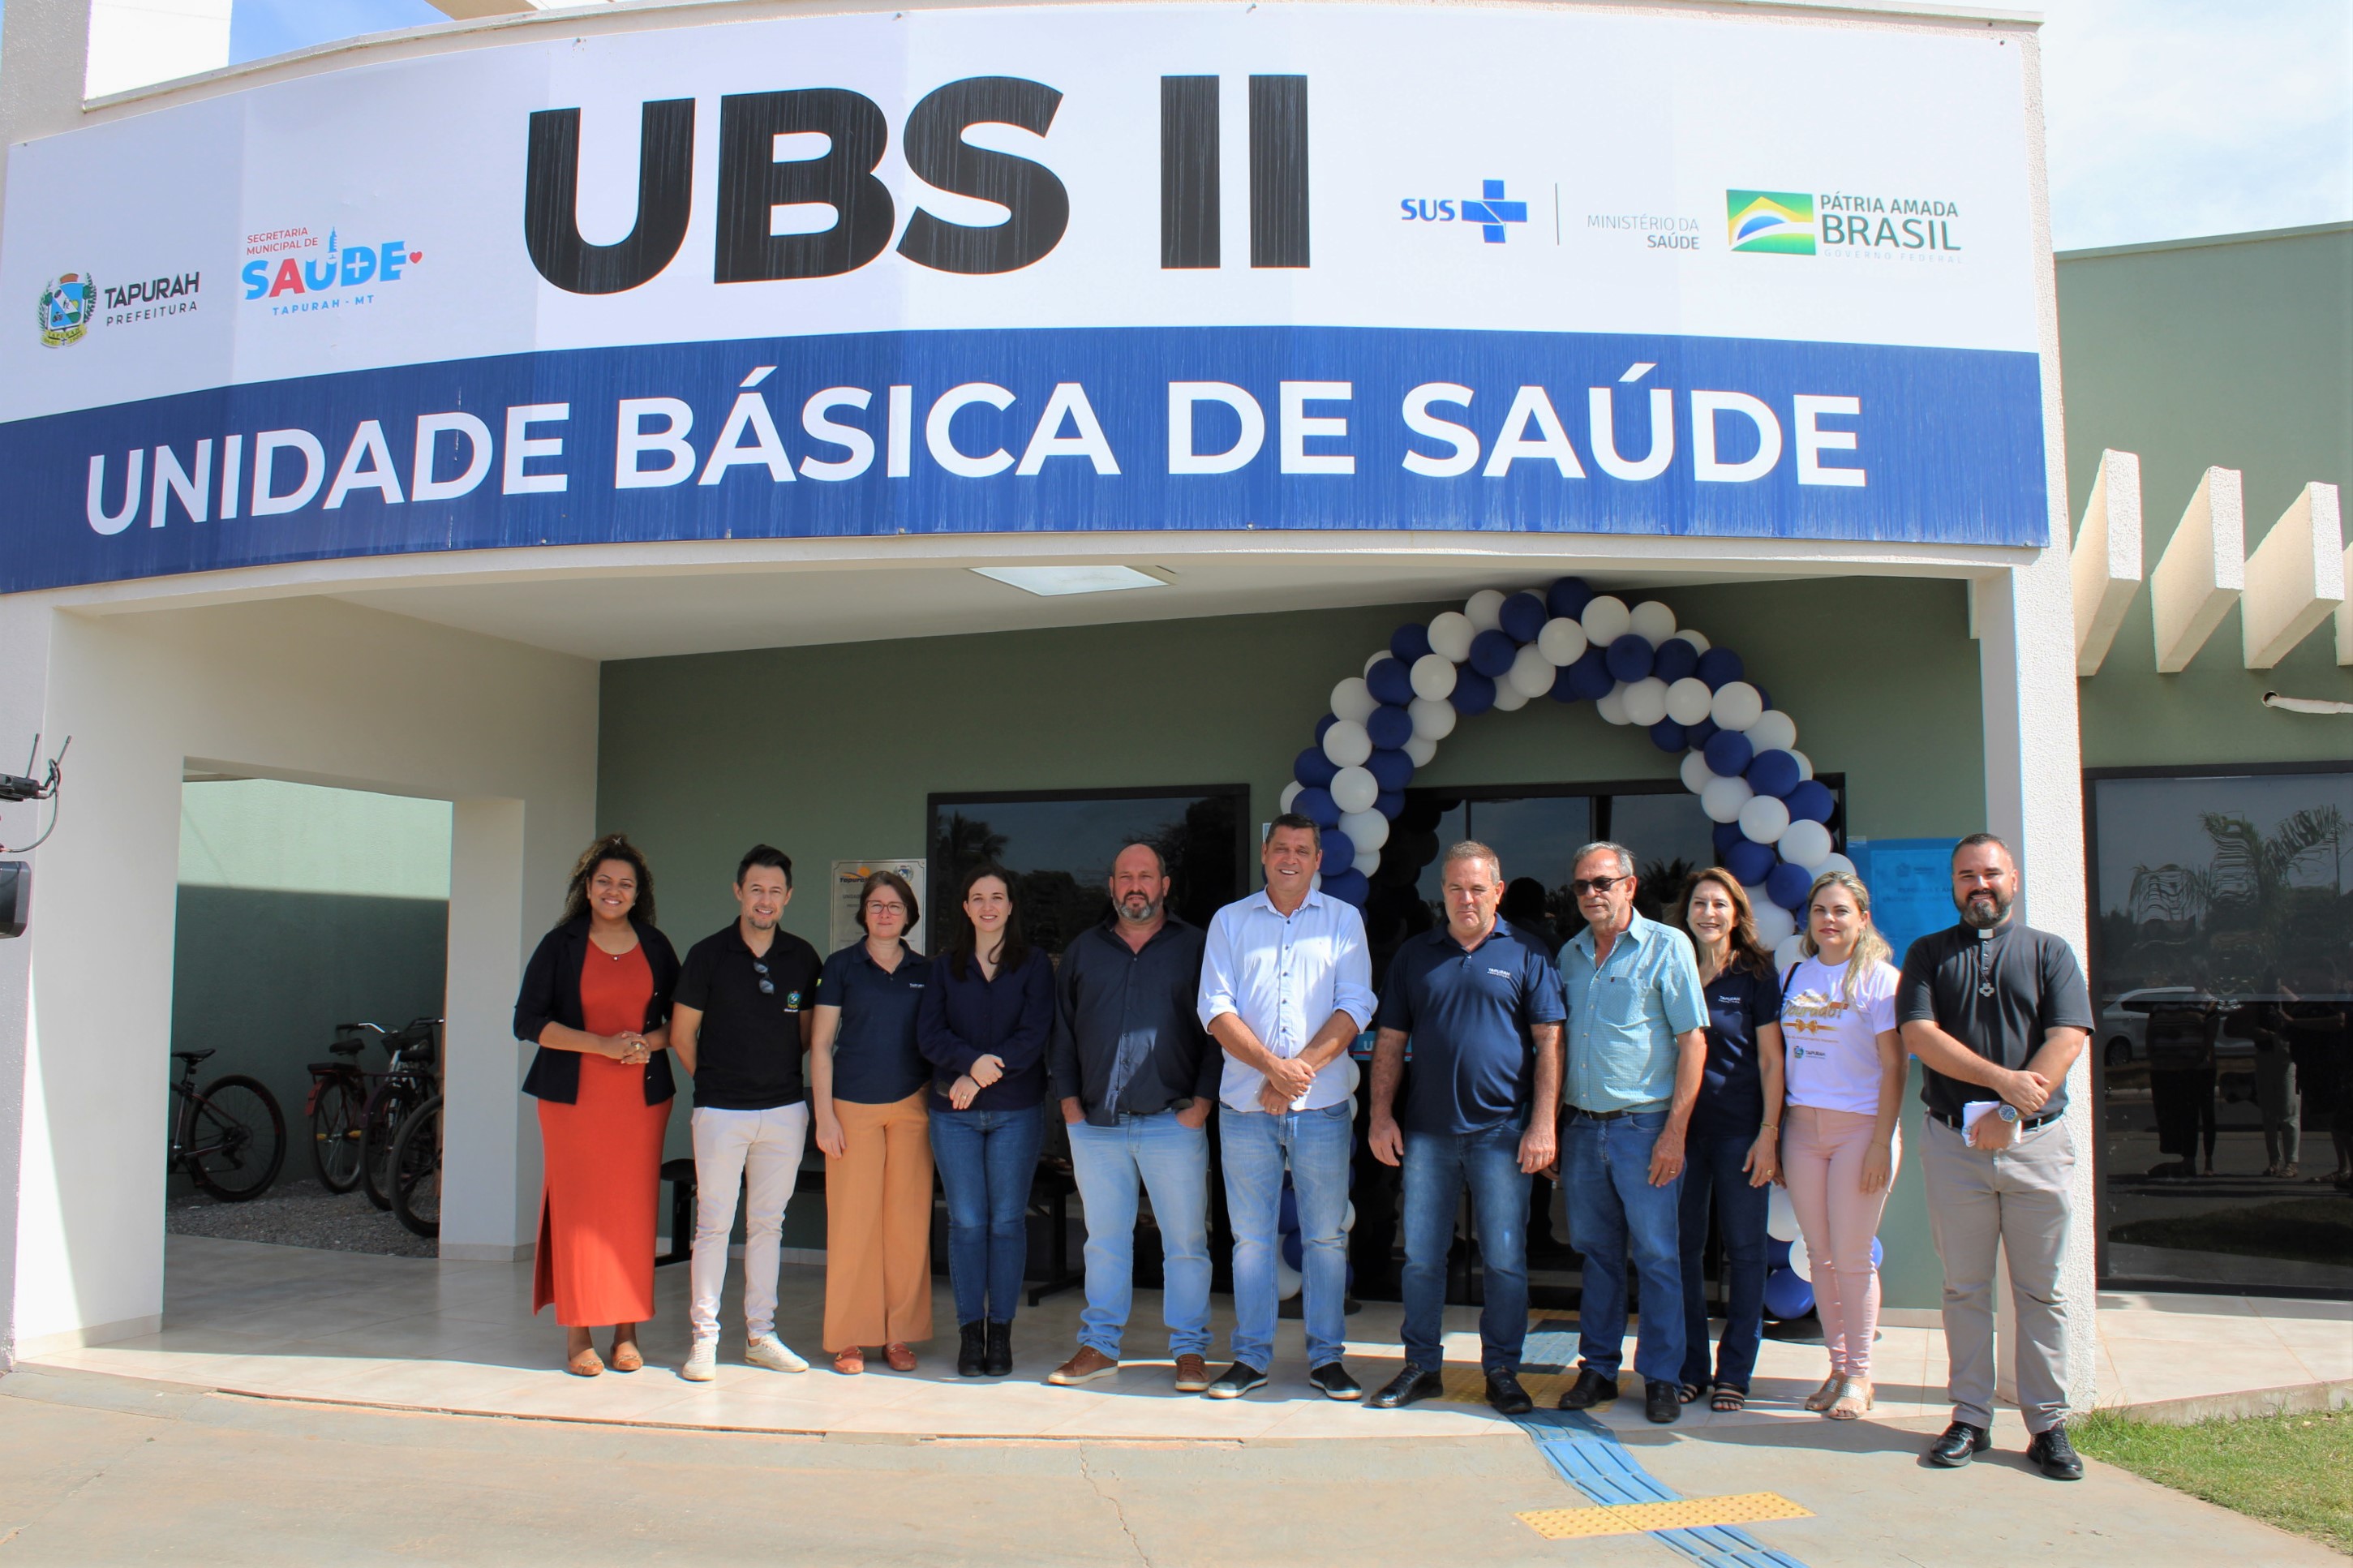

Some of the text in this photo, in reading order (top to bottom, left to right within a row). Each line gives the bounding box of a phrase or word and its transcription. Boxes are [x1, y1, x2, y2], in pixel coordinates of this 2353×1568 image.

[524, 75, 1311, 295] UBS II
[1401, 198, 1456, 221] SUS
[1820, 191, 1959, 217] PÁTRIA AMADA
[1587, 213, 1700, 232] MINISTÉRIO DA
[1822, 213, 1961, 251] BRASIL
[247, 226, 308, 244] SECRETARIA
[247, 237, 319, 256] MUNICIPAL DE
[1647, 232, 1700, 250] SAÚDE
[1824, 249, 1963, 264] GOVERNO FEDERAL
[105, 271, 200, 309] TAPURAH
[106, 301, 197, 326] PREFEITURA
[273, 299, 340, 316] TAPURAH
[355, 294, 375, 305] MT
[87, 363, 1866, 536] UNIDADE BÁSICA DE SAÚDE
